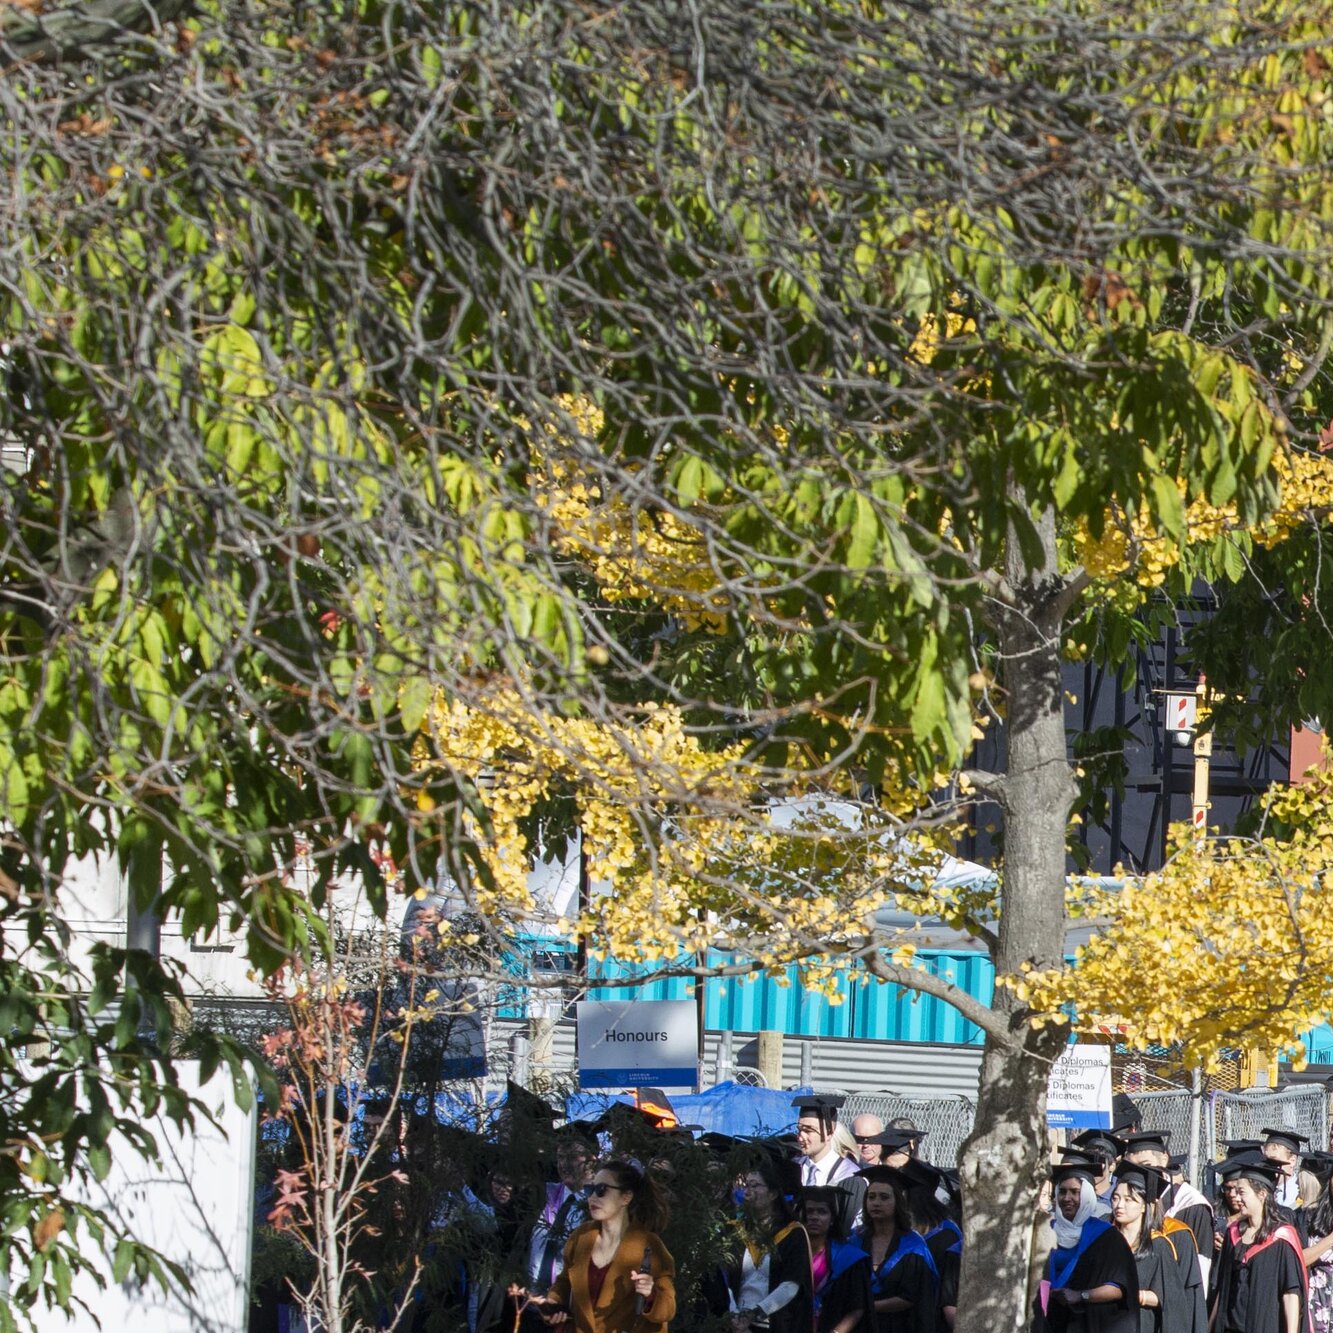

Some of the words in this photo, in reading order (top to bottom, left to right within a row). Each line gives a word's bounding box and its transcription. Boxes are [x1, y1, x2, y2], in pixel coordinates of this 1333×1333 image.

[605, 1030, 668, 1042] Honours
[1061, 1056, 1104, 1067] Diplomas
[1053, 1081, 1095, 1091] Diplomas
